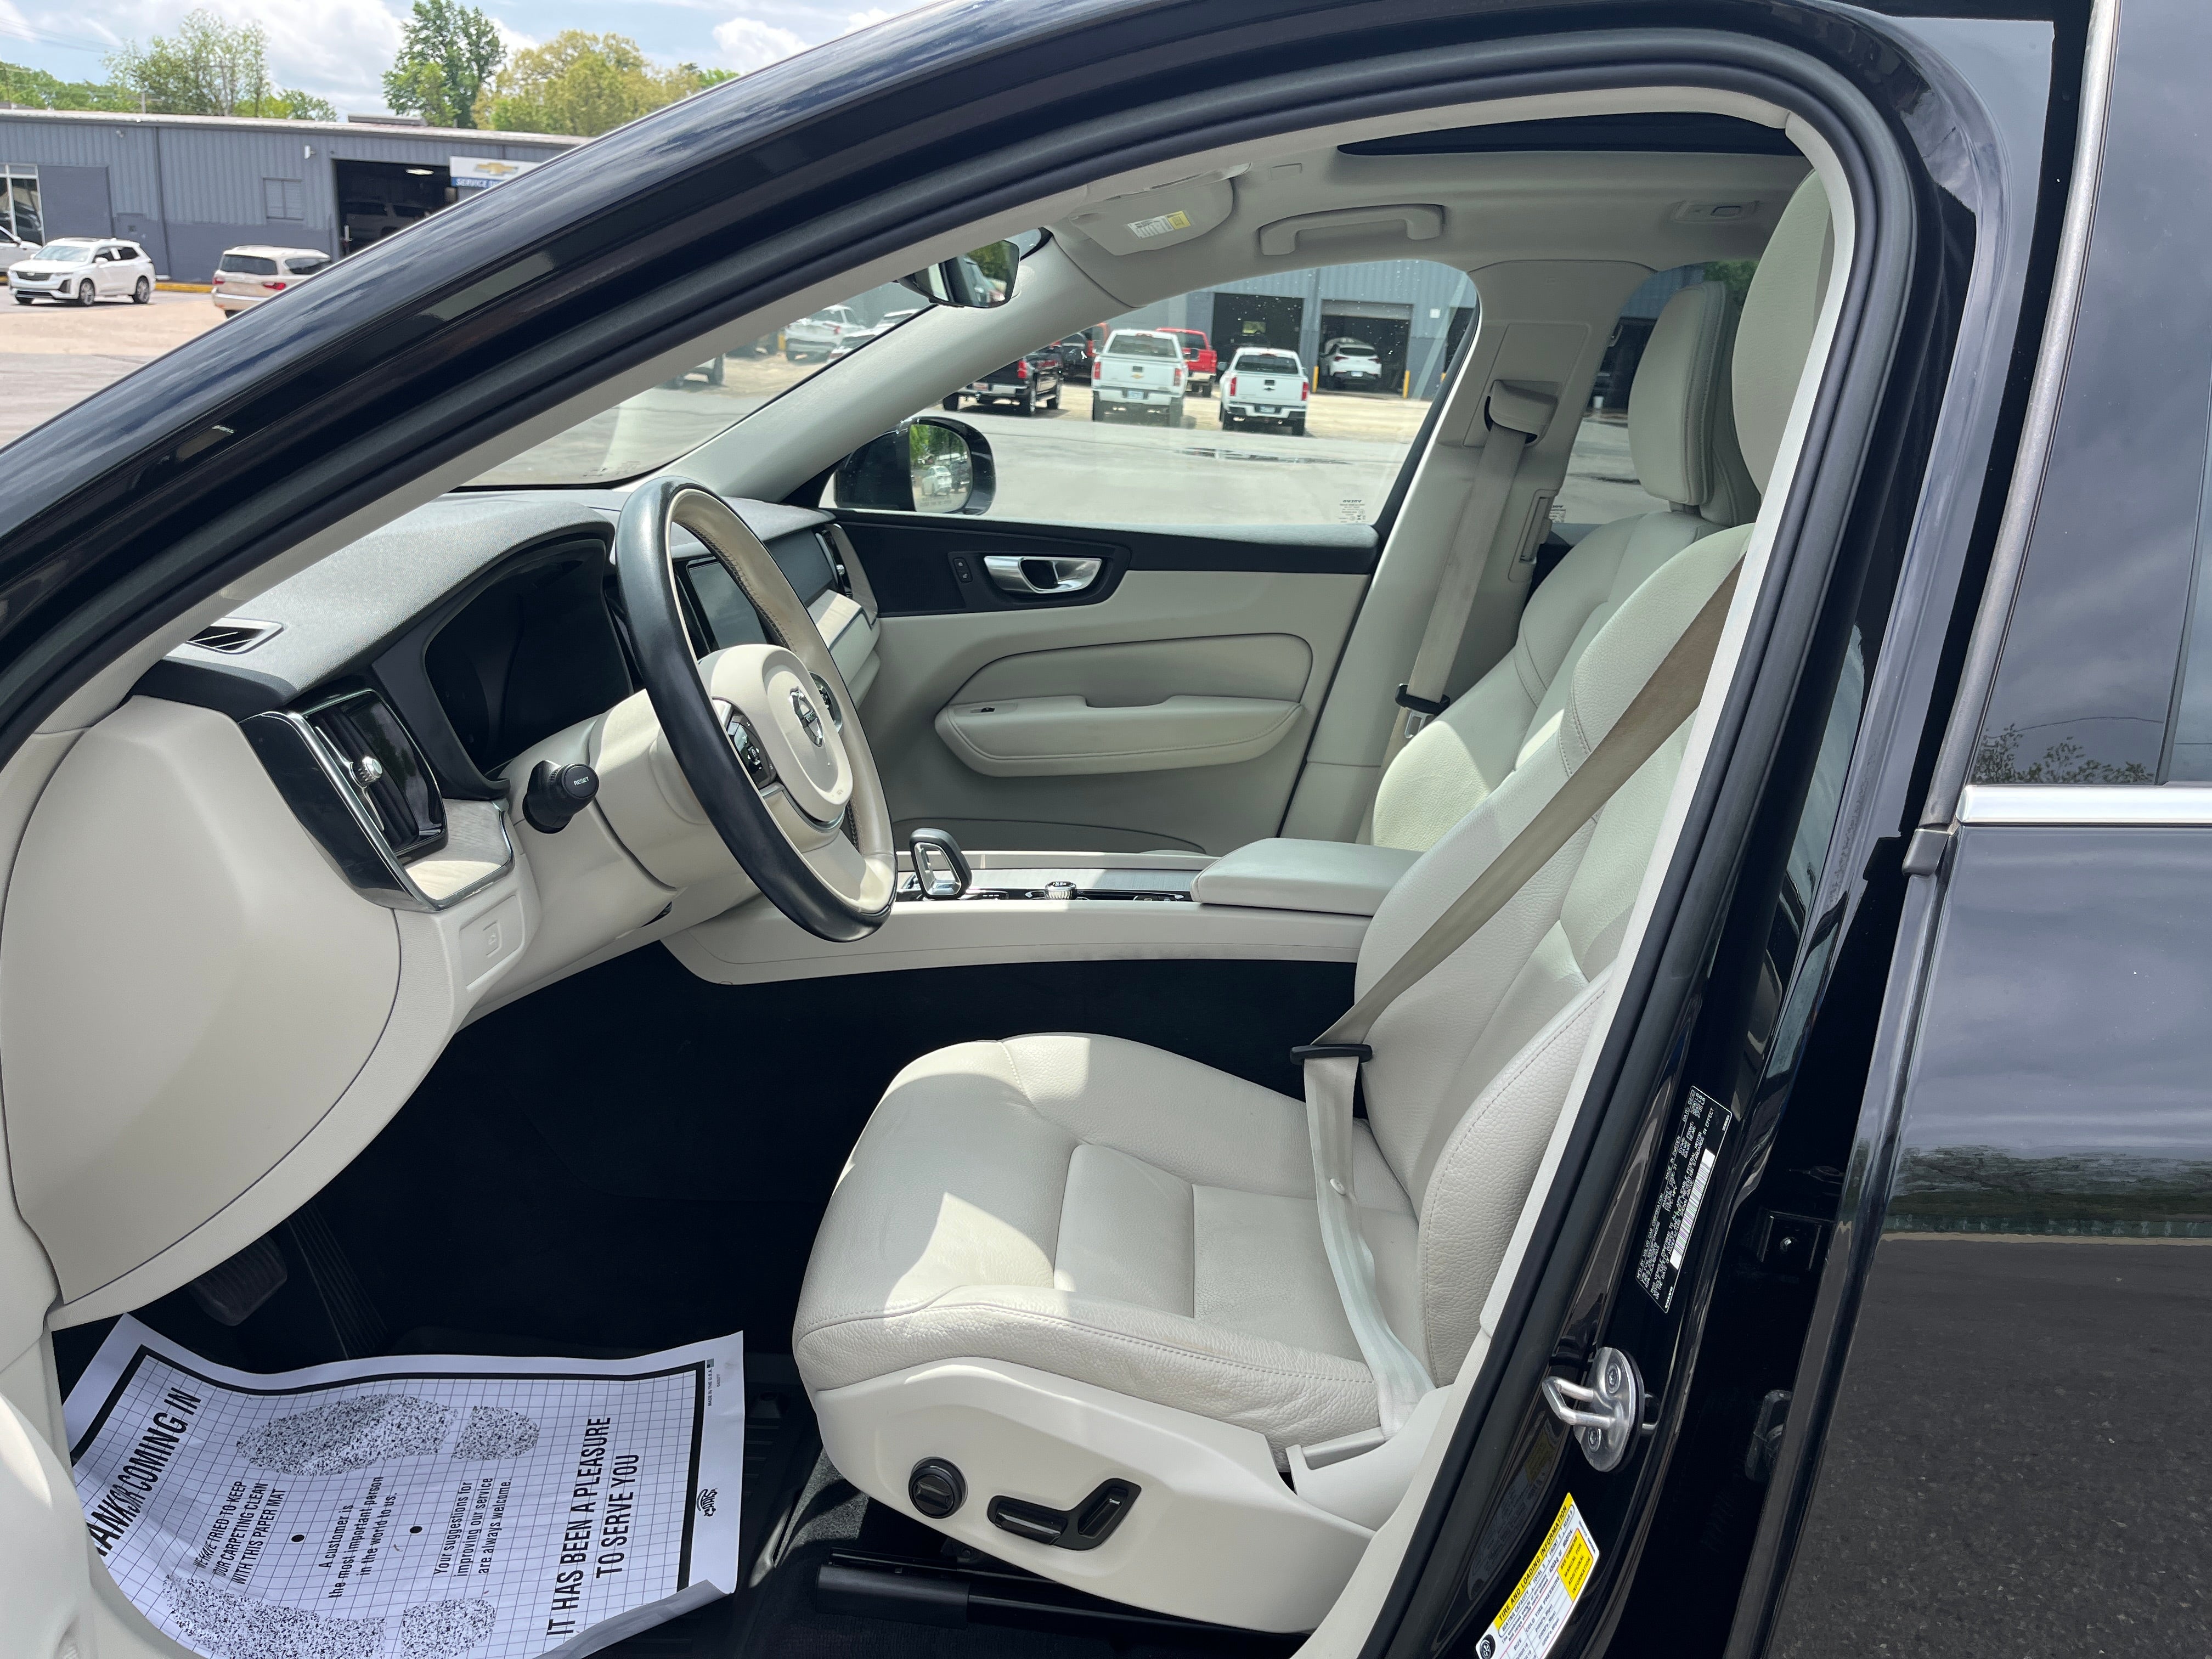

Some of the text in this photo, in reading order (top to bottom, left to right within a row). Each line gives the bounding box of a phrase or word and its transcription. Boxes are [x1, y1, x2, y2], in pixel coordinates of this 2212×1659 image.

[573, 776, 589, 786] RESET
[1672, 1135, 1680, 1156] SWEDEN
[1692, 1135, 1704, 1167] STANDARDS
[1705, 1107, 1714, 1127] EFFECT
[1651, 1192, 1663, 1227] CORPORATION
[1669, 1221, 1673, 1229] TO
[1686, 1152, 1695, 1175] FEDERAL
[1664, 1284, 1674, 1310] VOLVO
[117, 1412, 189, 1493] COMING
[163, 1387, 201, 1416] IN
[219, 1505, 237, 1516] TO
[225, 1481, 247, 1503] KEEP
[207, 1517, 230, 1542] TRIED
[220, 1511, 255, 1561] CARPETING
[244, 1482, 268, 1510] CLEAN
[230, 1488, 286, 1584] WITH THIS PAPER MAT
[328, 1476, 384, 1598] the most important person
[357, 1493, 397, 1576] in the world to us.
[433, 1482, 472, 1575] Your suggestions for
[455, 1478, 493, 1576] improving our service
[478, 1479, 512, 1573] are always welcome.
[546, 1417, 611, 1636] IT HAS BEEN A PLEASURE
[596, 1454, 639, 1579] TO SERVE YOU
[198, 1540, 217, 1562] HAVE
[324, 1516, 349, 1559] customer
[1549, 1539, 1558, 1557] FRONT
[1566, 1534, 1577, 1559] OWNERS
[1498, 1504, 1567, 1622] TIRE AND LOADING INFORMATION
[1533, 1568, 1542, 1584] TOTAL
[1564, 1554, 1576, 1578] MANUAL
[1567, 1554, 1584, 1587] ADDITIONAL
[1572, 1556, 1590, 1595] INFORMATION
[1502, 1588, 1529, 1632] SEATING CAPACITY
[1508, 1613, 1521, 1637] combined
[1521, 1599, 1531, 1617] weight
[1513, 1575, 1559, 1652] SIZE COLD TIRE PRESSURE
[1514, 1618, 1522, 1634] cargo
[1521, 1604, 1531, 1621] should
